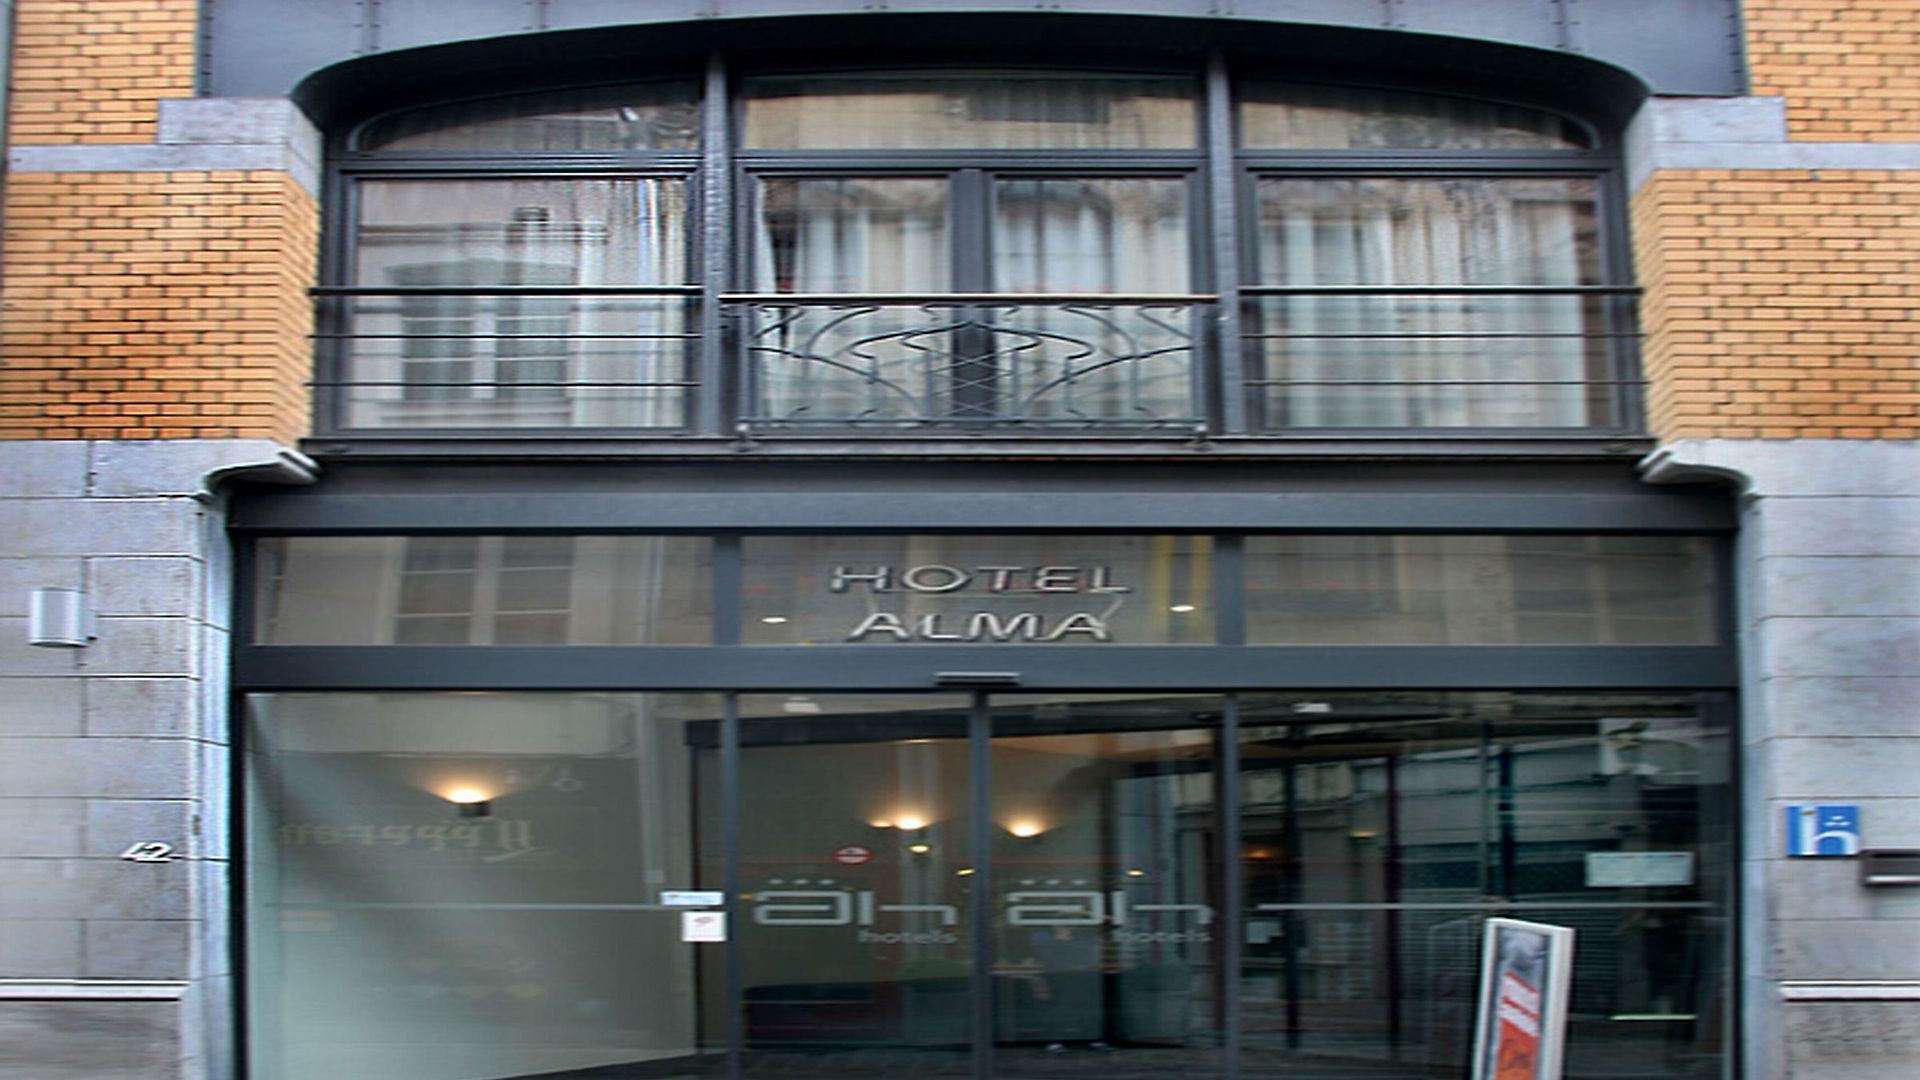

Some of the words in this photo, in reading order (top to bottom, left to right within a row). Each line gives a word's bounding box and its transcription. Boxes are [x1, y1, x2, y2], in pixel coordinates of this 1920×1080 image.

[829, 565, 1130, 594] HOTEL
[848, 612, 1110, 641] ALMA
[859, 930, 958, 944] hotels
[1114, 930, 1213, 944] hotels
